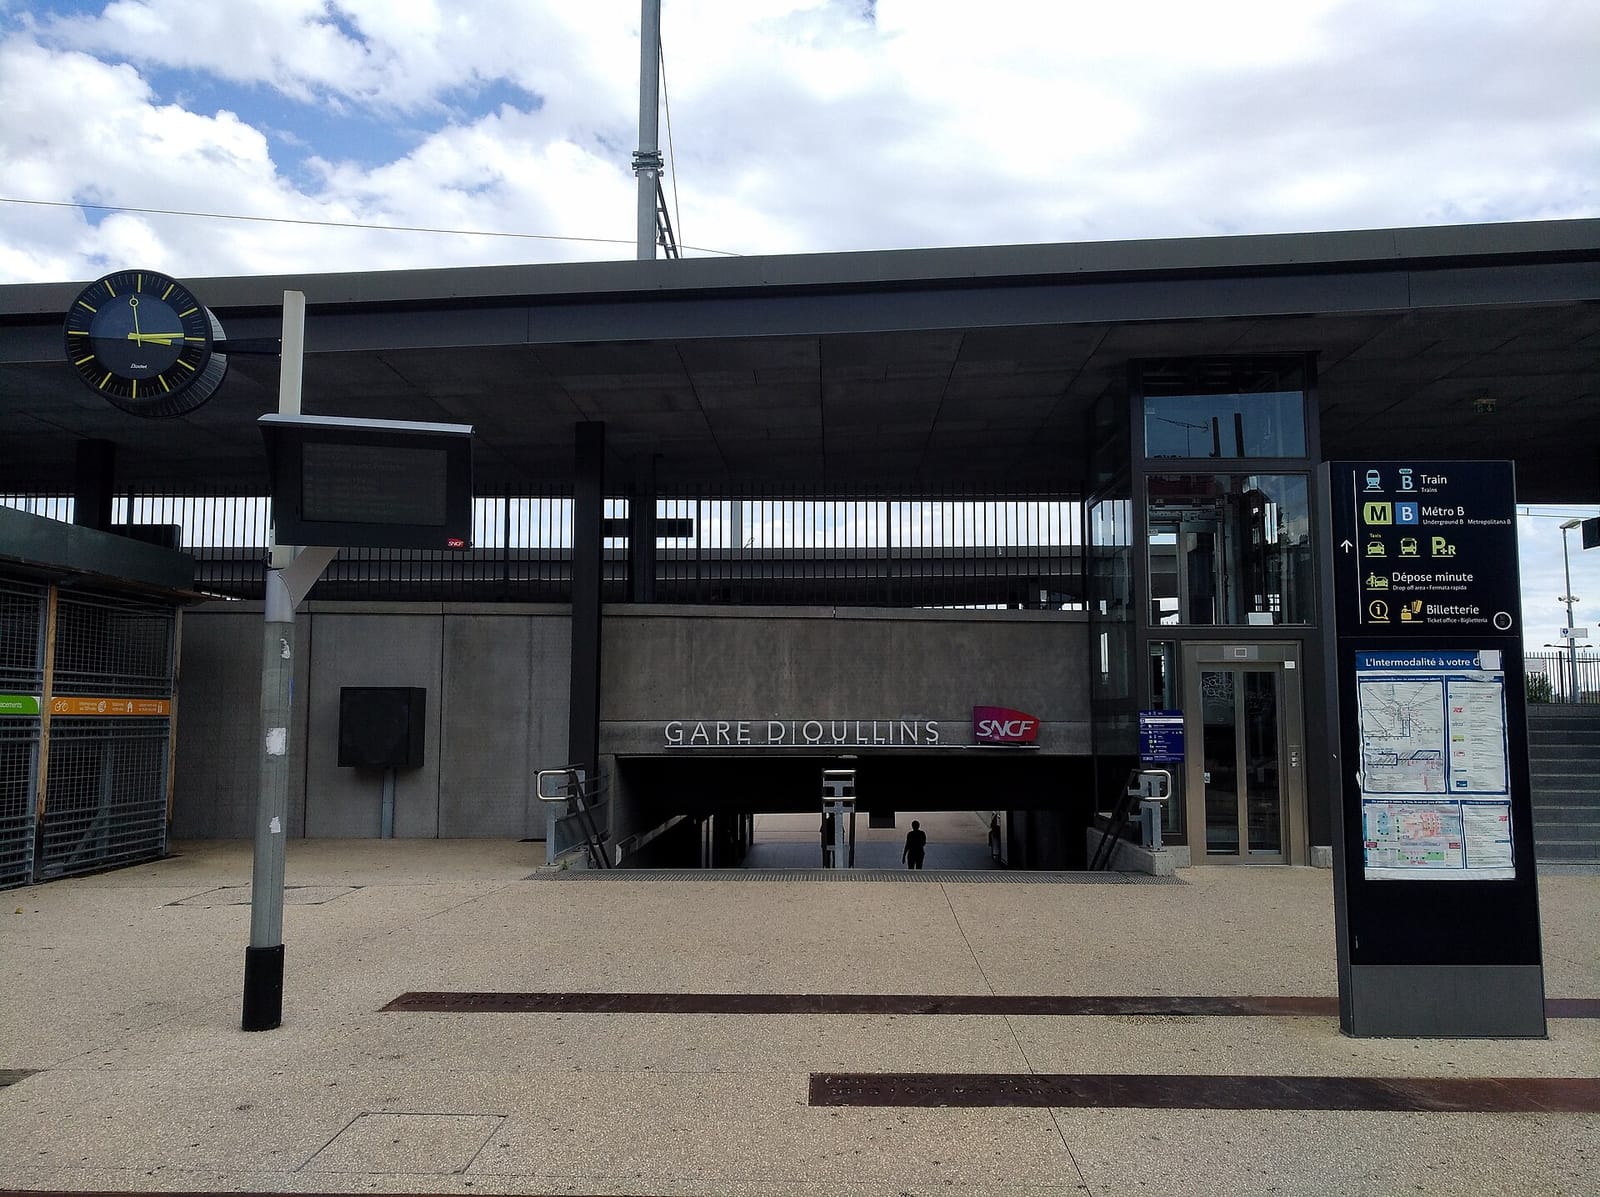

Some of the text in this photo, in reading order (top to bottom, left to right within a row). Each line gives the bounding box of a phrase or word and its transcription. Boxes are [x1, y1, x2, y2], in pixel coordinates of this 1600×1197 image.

[1420, 474, 1447, 485] Train
[1370, 505, 1387, 521] M
[1402, 506, 1413, 521] B
[1422, 506, 1465, 516] Métro B
[1392, 572, 1473, 584] Dépose minute
[1426, 604, 1480, 615] Billetterie
[1365, 657, 1480, 667] L'Intermodalité à votre G
[665, 721, 751, 742] GARE
[976, 719, 1035, 737] SNCF
